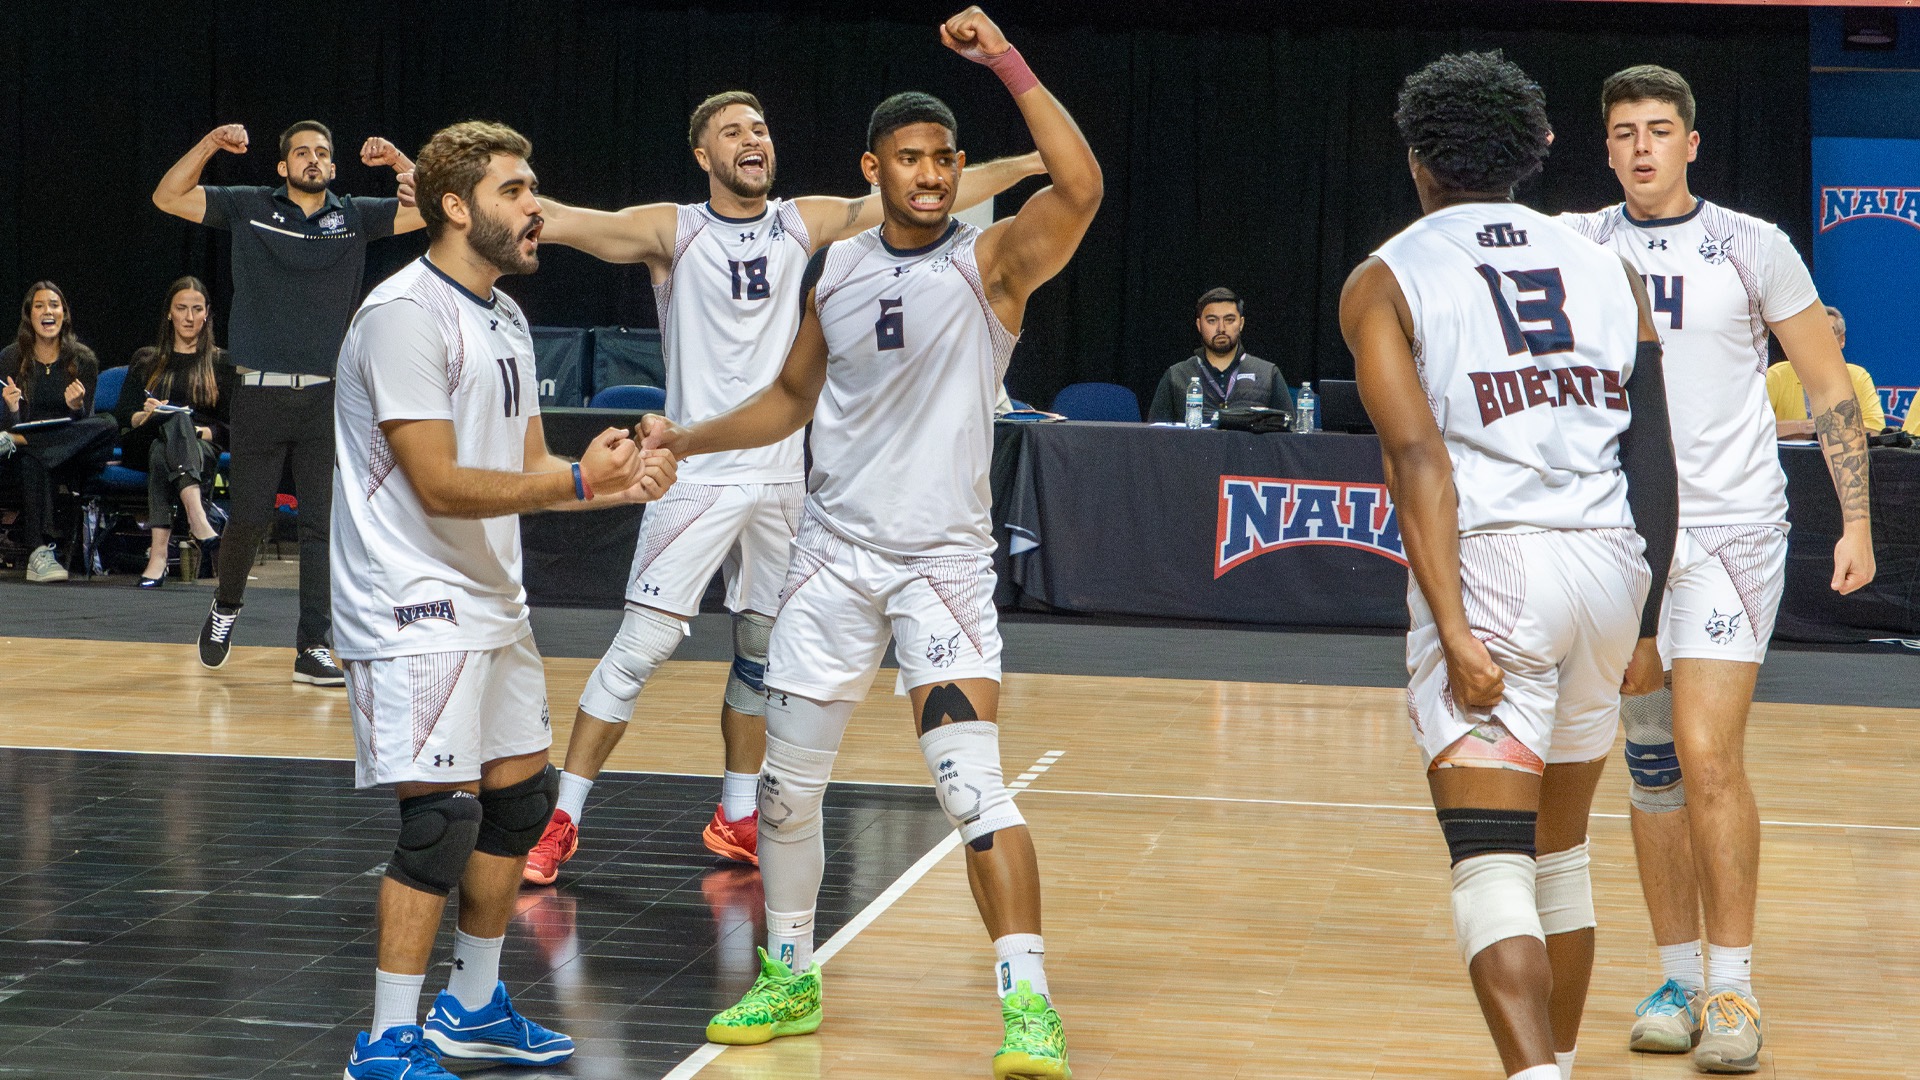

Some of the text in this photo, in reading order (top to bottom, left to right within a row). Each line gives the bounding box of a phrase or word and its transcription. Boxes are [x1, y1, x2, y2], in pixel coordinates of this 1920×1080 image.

[1476, 222, 1528, 248] STU
[1823, 188, 1920, 230] NAIA
[728, 256, 771, 301] 18
[1639, 273, 1684, 330] 4
[875, 295, 905, 351] 6
[1474, 263, 1575, 357] 13
[496, 357, 520, 418] 11
[1467, 365, 1630, 428] BOBCATS
[395, 600, 456, 628] NAIA
